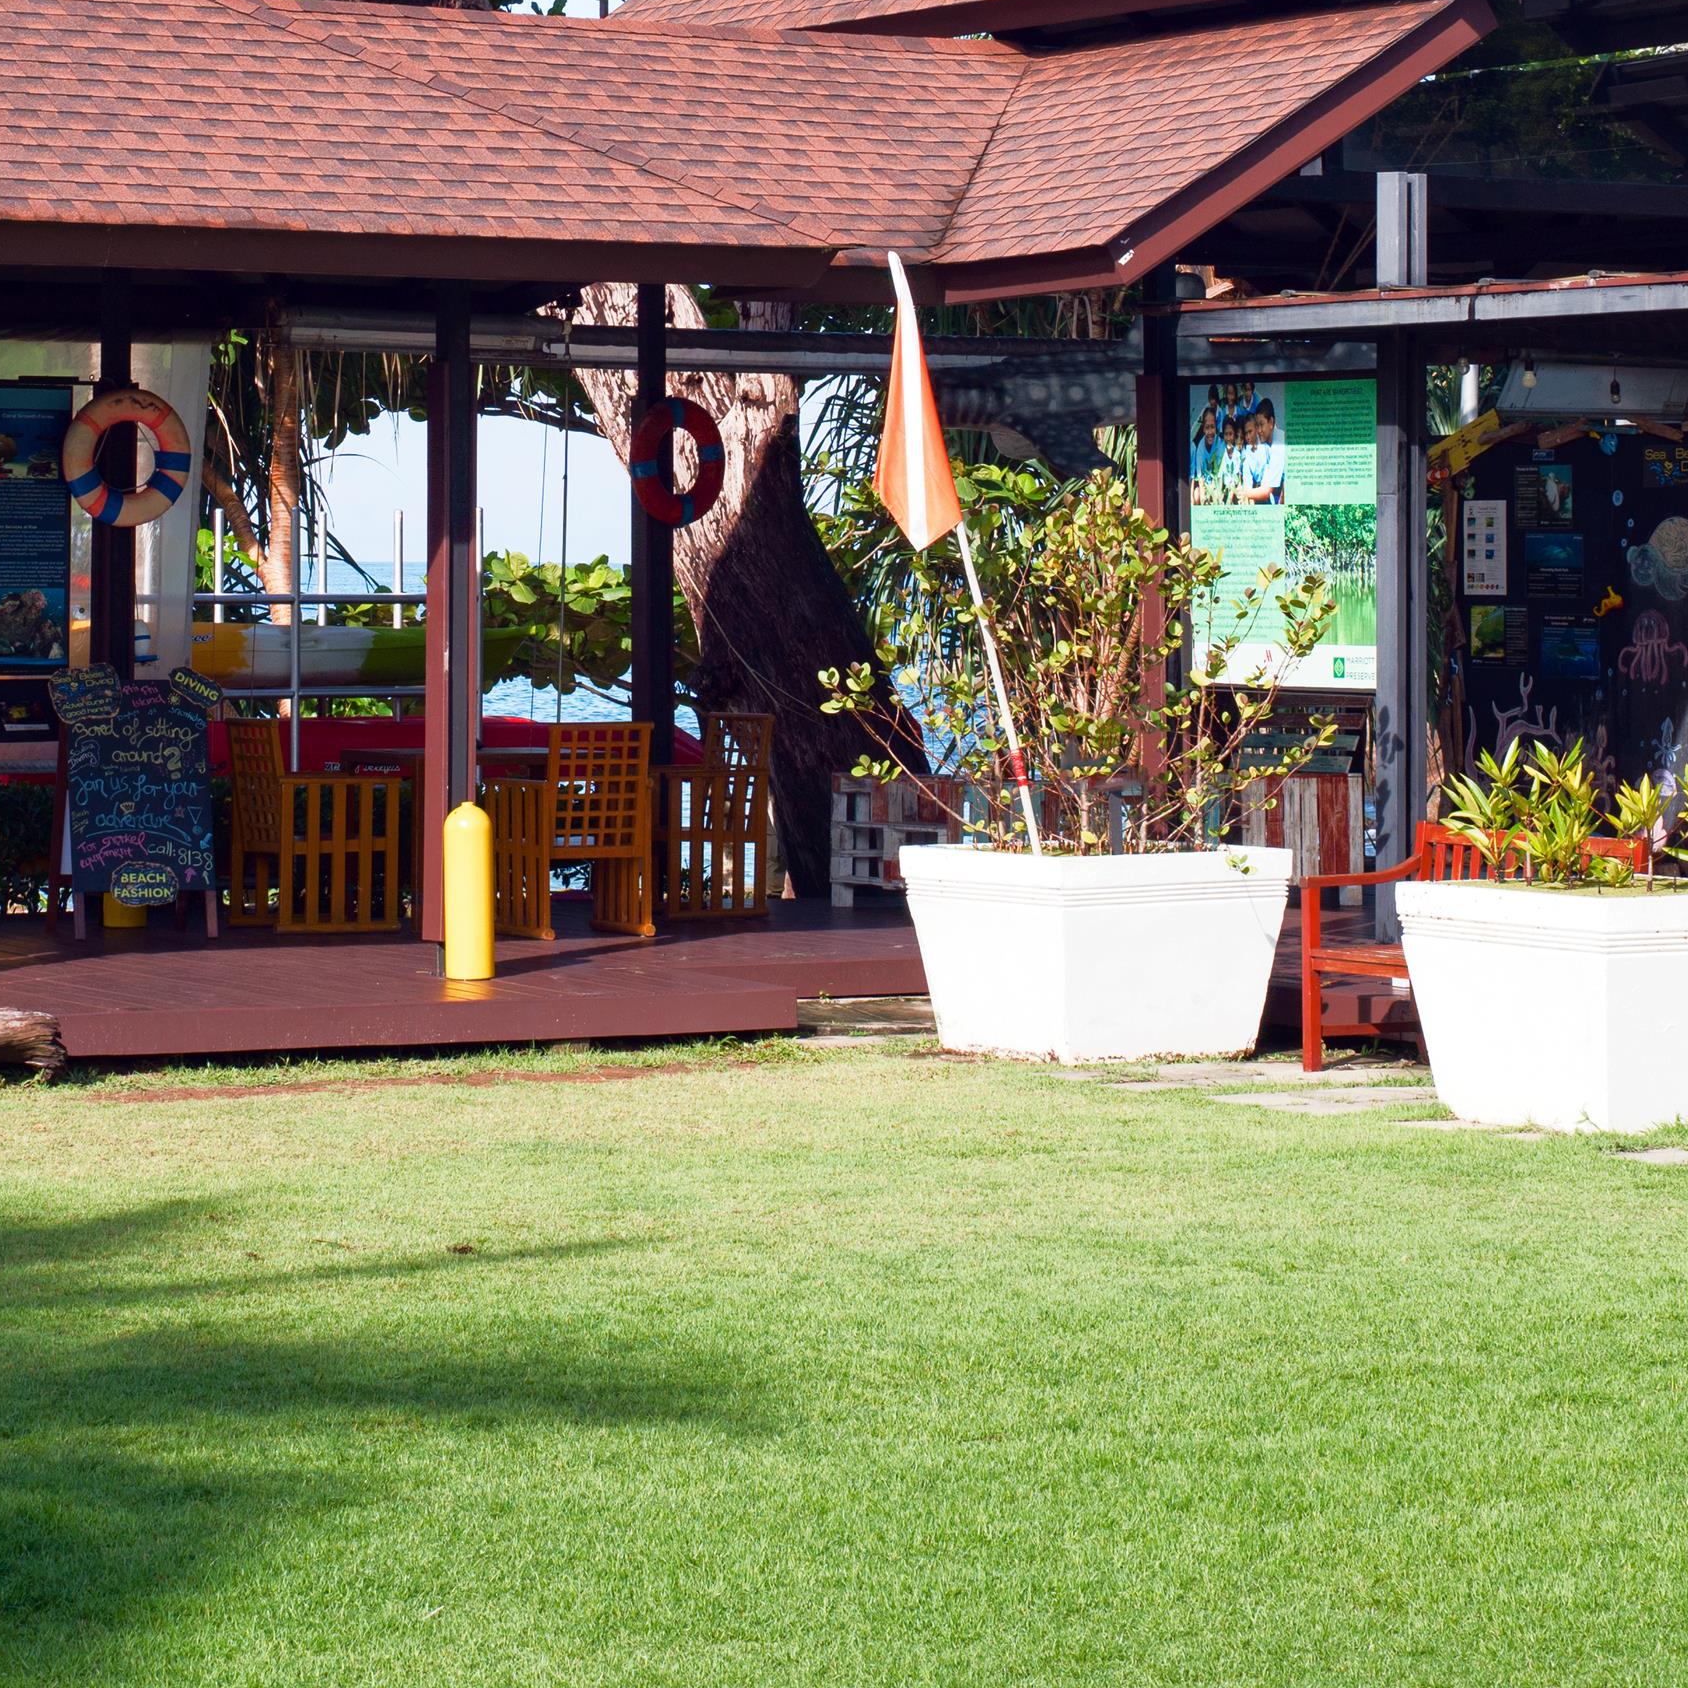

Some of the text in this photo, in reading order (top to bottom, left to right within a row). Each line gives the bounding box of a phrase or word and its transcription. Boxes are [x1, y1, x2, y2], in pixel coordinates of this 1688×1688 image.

[1644, 448, 1666, 461] Sea
[174, 671, 219, 701] DIVING
[71, 716, 200, 752] Bored of sitting
[132, 774, 163, 802] for
[163, 782, 206, 811] your
[95, 801, 184, 832] adventure
[147, 841, 177, 858] call:
[178, 848, 214, 871] 8138
[114, 888, 174, 899] FASHION
[121, 873, 166, 884] BEACH
